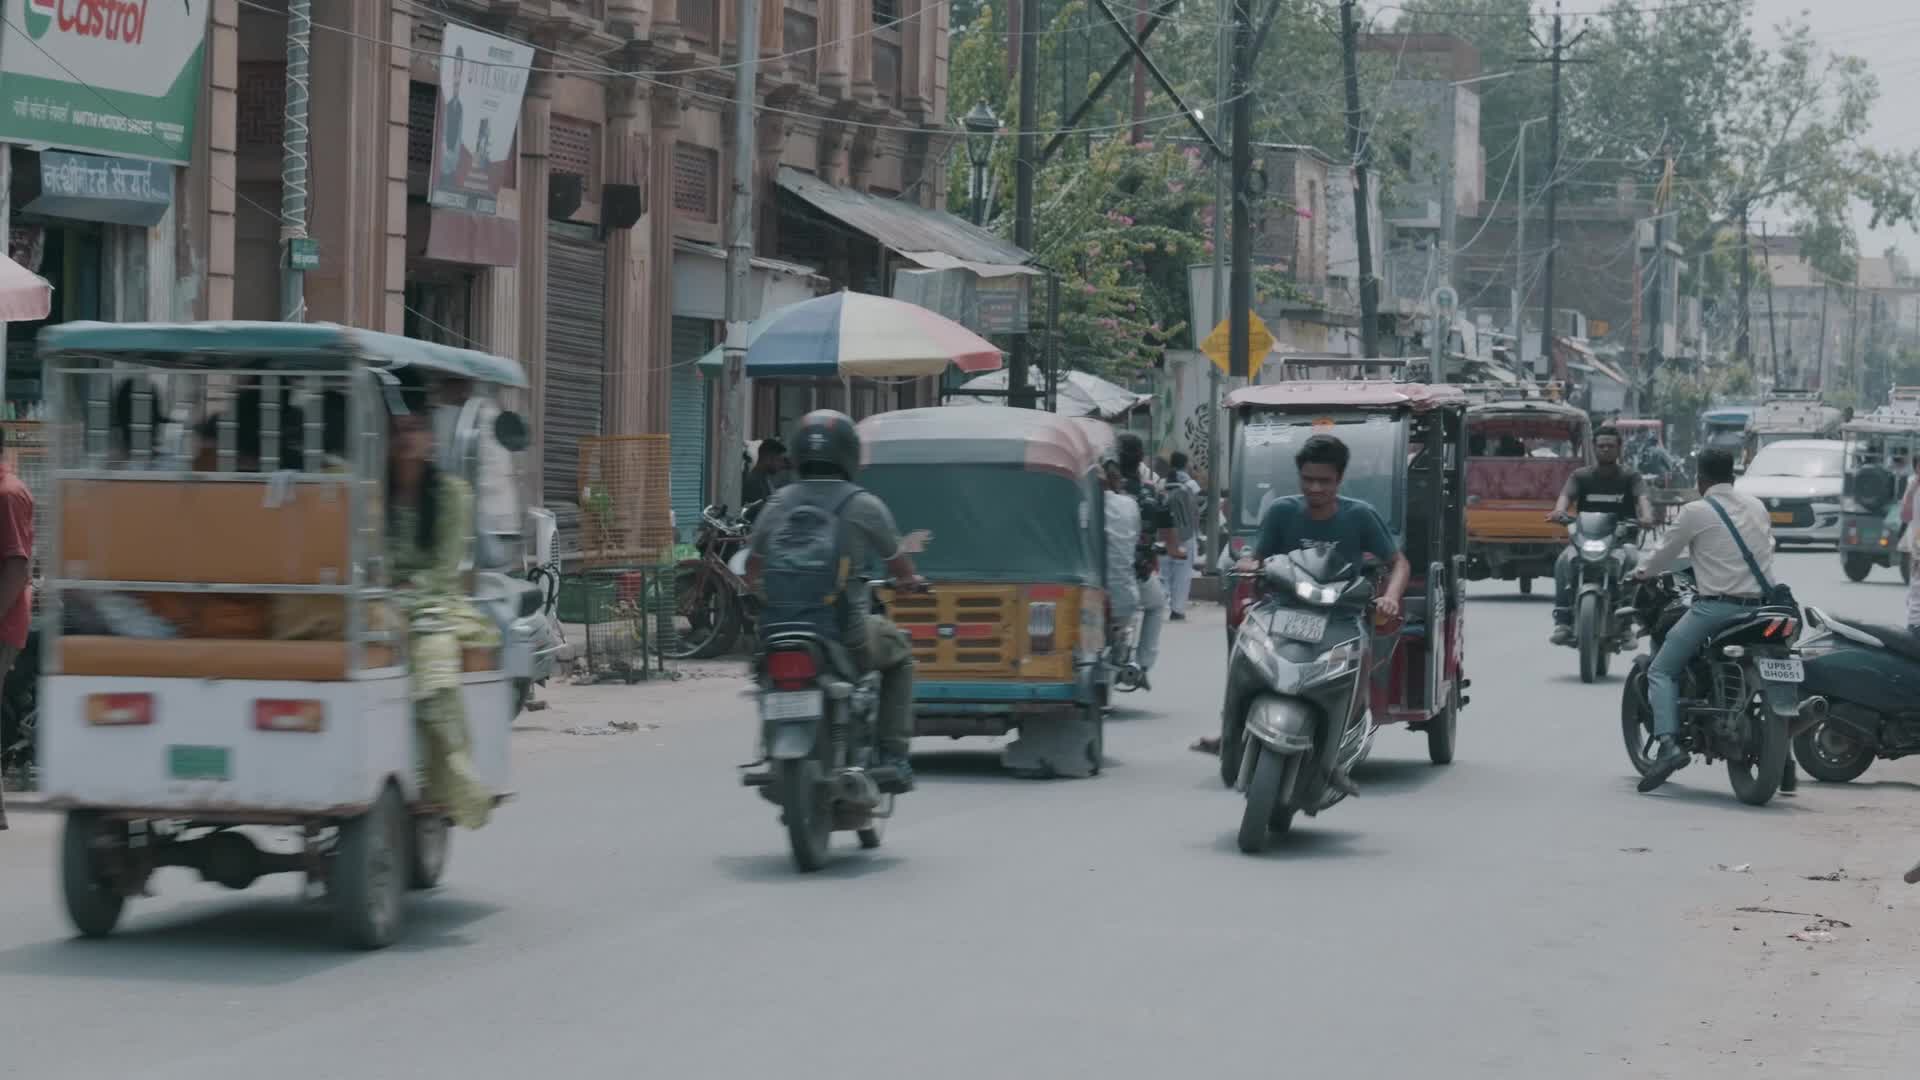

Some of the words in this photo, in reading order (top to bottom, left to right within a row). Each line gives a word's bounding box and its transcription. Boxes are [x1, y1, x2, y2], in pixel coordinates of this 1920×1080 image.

[57, 0, 147, 44] Castrol
[1767, 662, 1792, 671] UP85
[1764, 670, 1800, 679] BH0651
